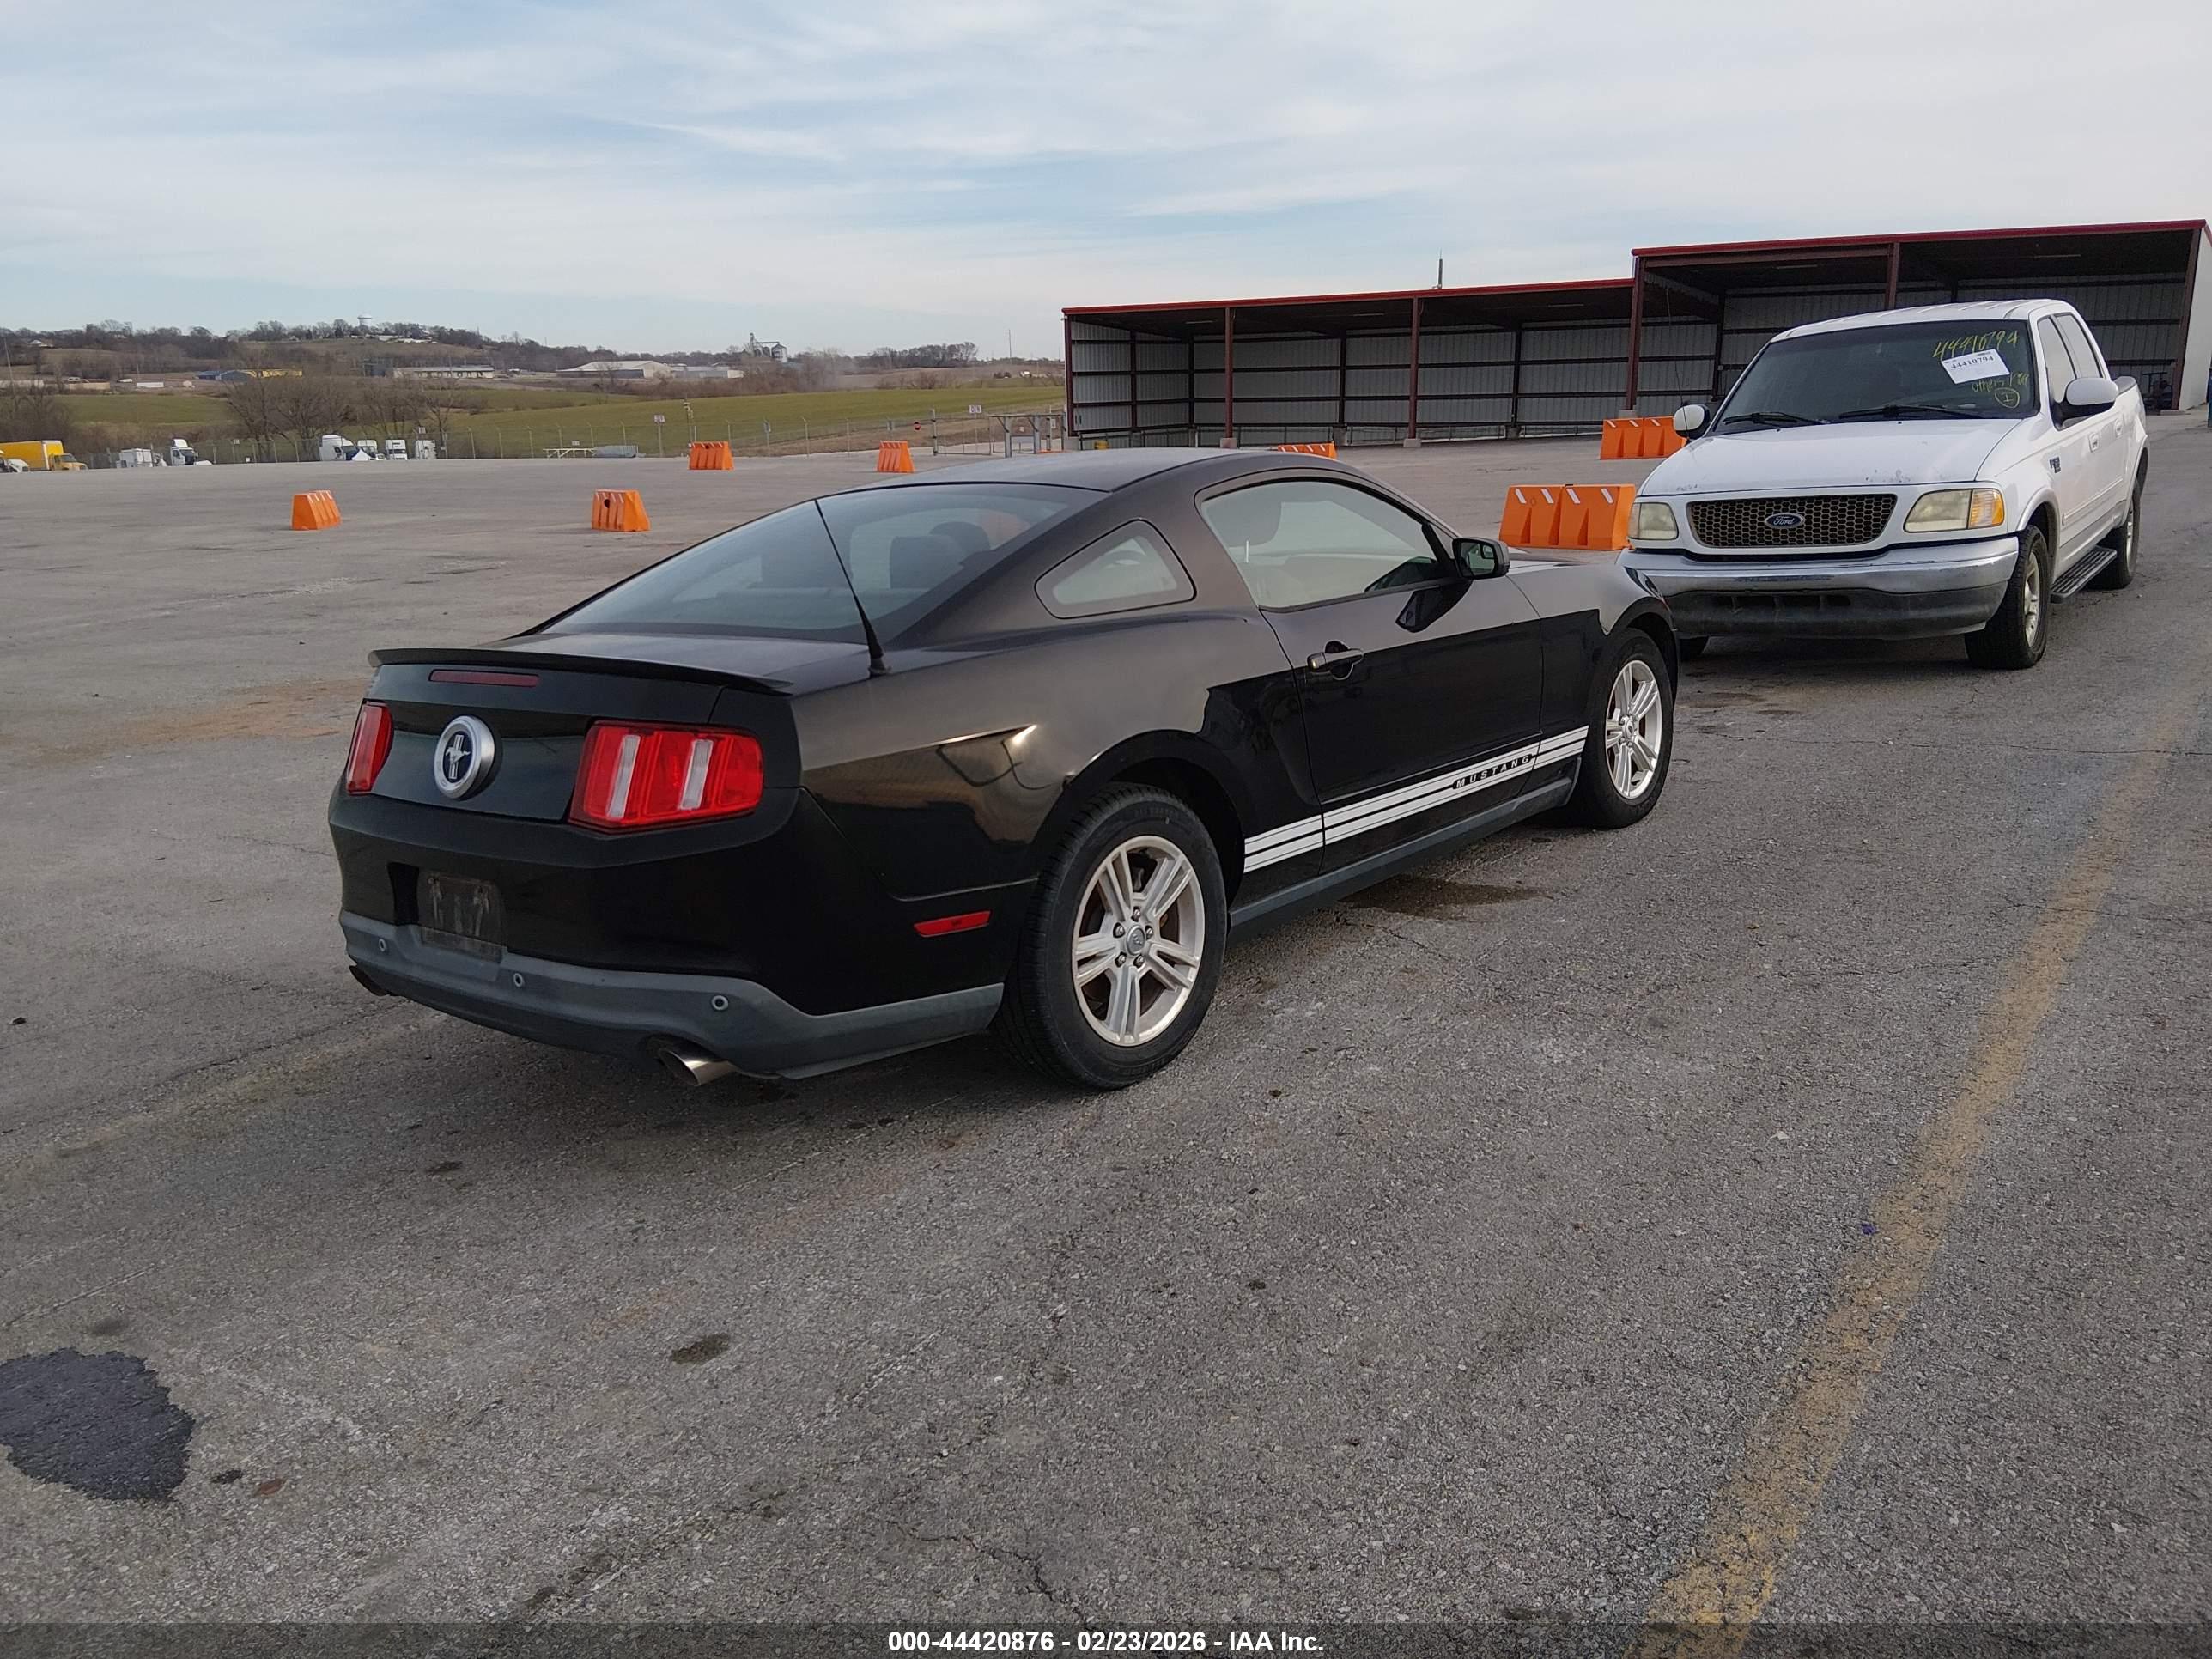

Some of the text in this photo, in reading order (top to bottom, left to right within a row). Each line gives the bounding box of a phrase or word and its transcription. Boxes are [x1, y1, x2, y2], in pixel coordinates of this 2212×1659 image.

[1951, 356, 1994, 368] 44410794
[1773, 516, 1795, 525] Ford
[1456, 756, 1529, 787] MUSTANG
